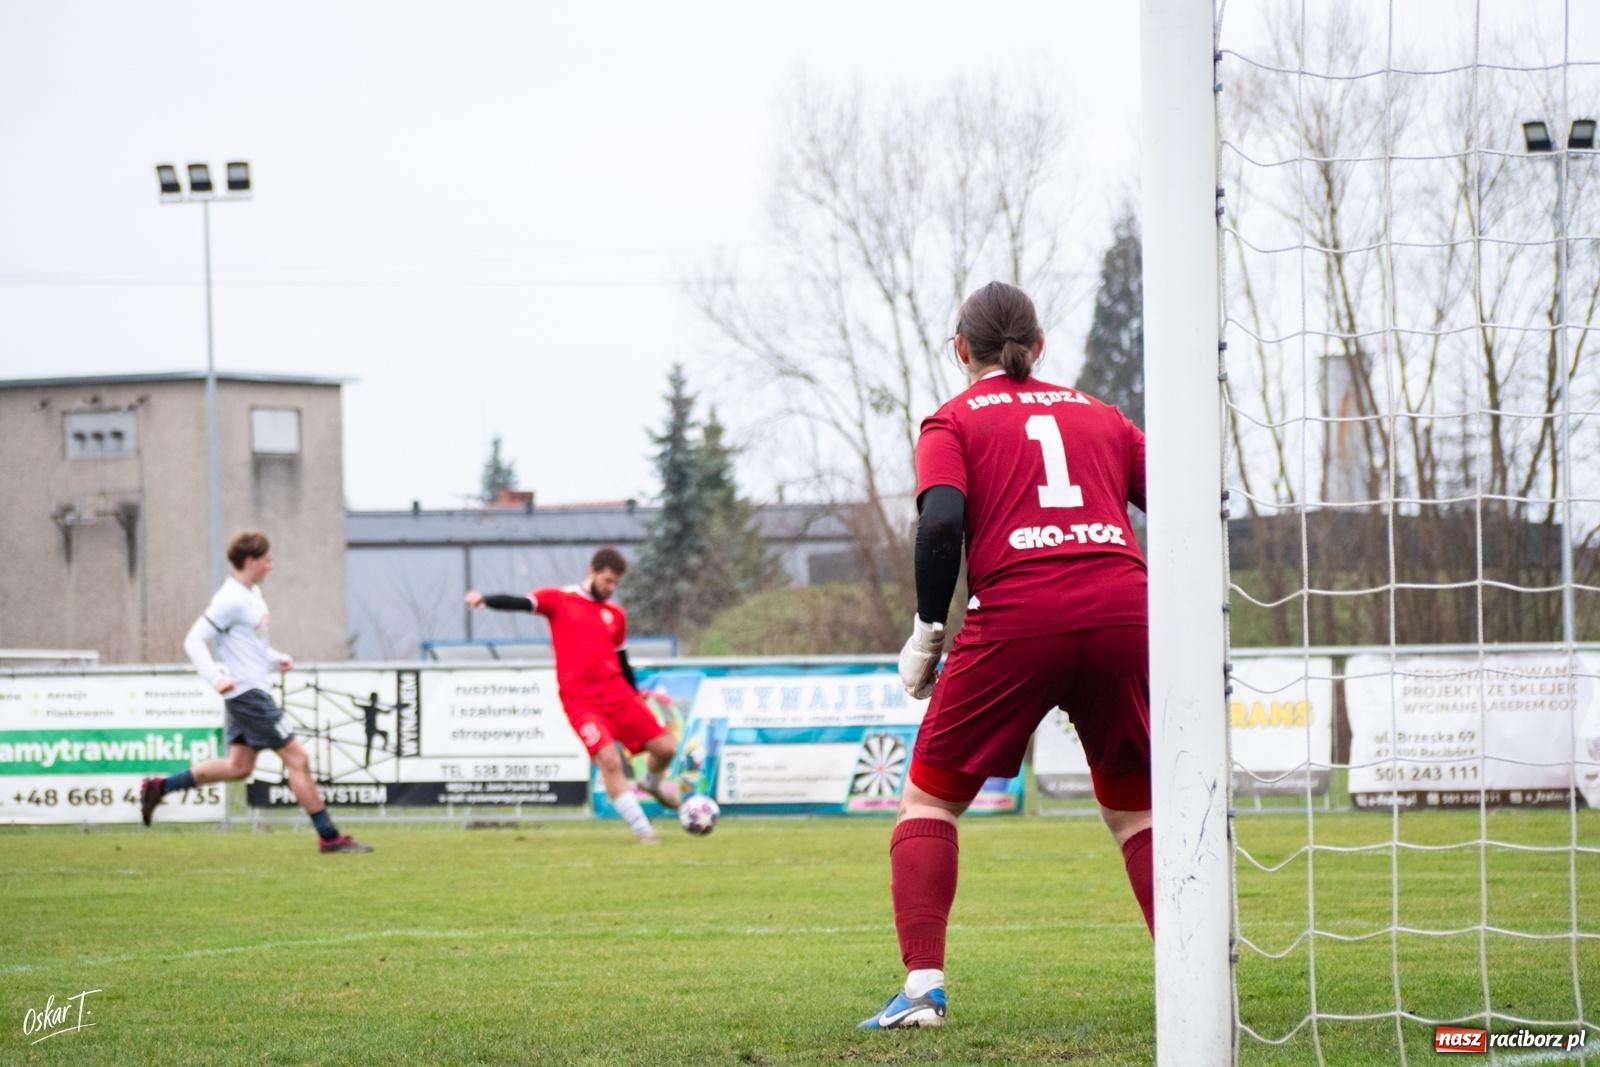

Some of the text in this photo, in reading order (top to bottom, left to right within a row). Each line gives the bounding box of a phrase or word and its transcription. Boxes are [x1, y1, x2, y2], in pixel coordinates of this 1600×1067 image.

[1024, 415, 1084, 508] 1
[720, 684, 909, 711] WYNAJEM
[1487, 684, 1505, 697] ZE
[1376, 766, 1478, 781] 501 243 111
[13, 788, 59, 806] +48
[68, 788, 114, 806] 668
